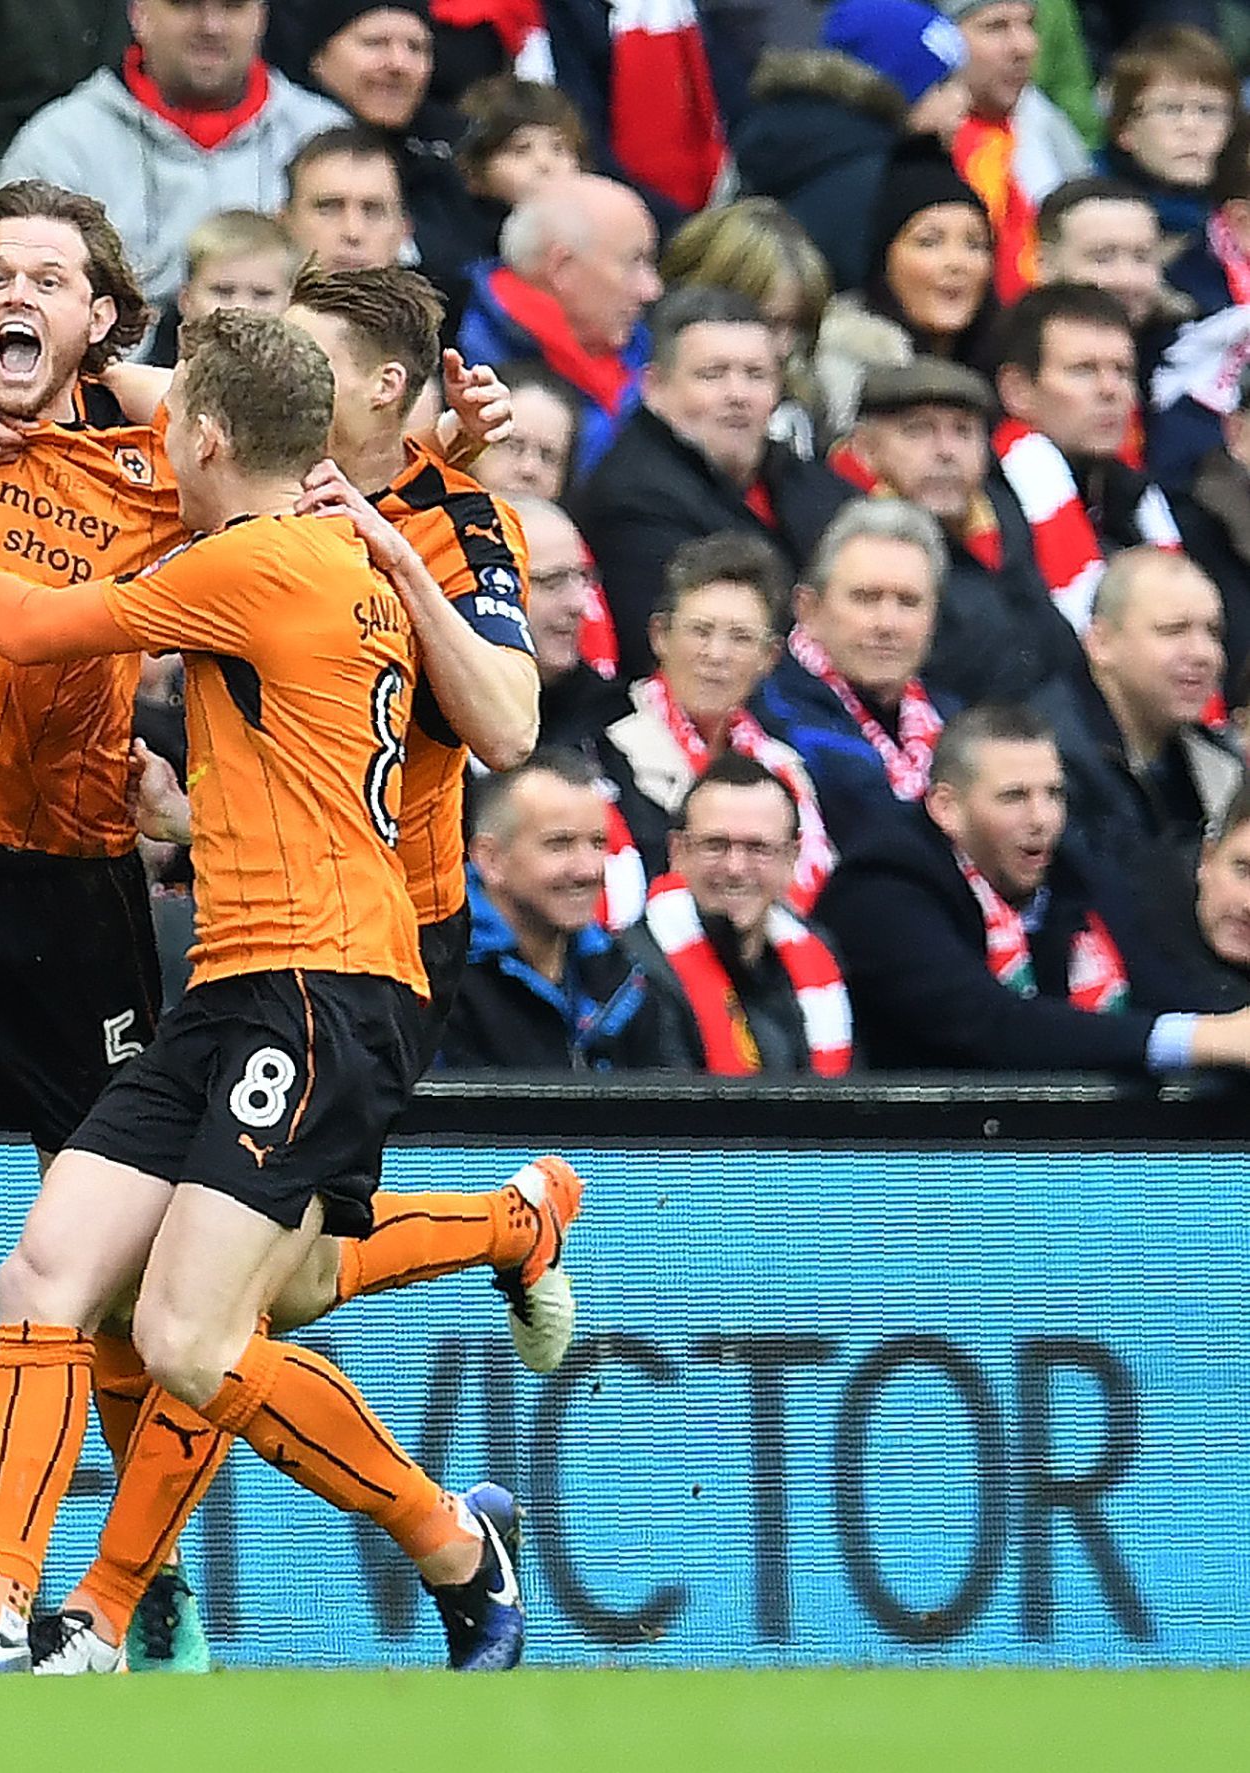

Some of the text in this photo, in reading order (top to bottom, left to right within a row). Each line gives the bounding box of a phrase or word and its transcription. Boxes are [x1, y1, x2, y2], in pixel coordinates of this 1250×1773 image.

[2, 528, 93, 585] shop
[103, 1008, 145, 1066] 5
[229, 1046, 297, 1128] 8
